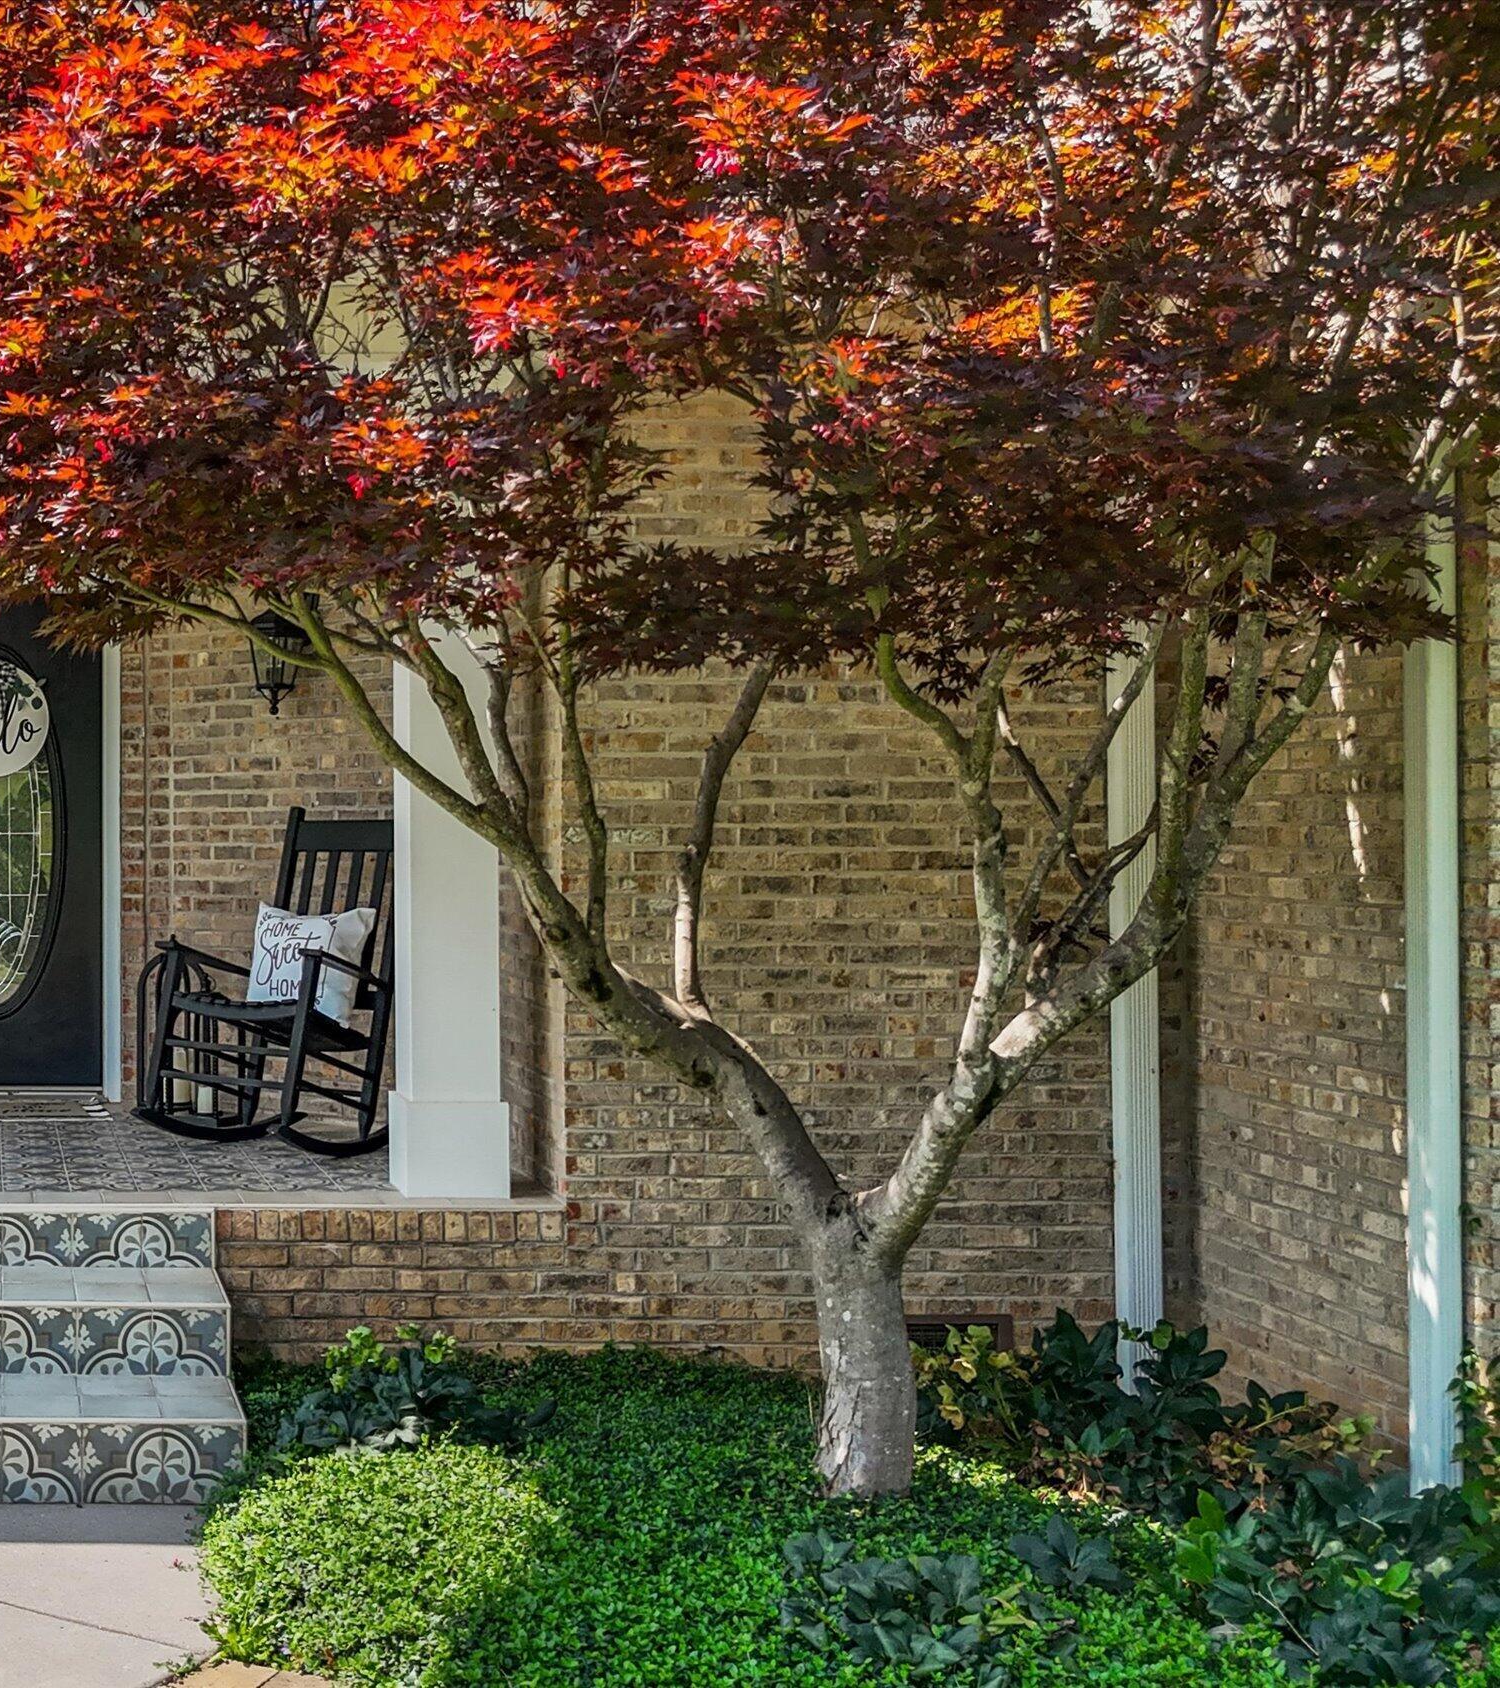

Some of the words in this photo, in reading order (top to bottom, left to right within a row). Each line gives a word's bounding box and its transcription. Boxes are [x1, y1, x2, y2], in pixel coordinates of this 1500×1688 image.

[264, 921, 303, 939] HOME
[256, 929, 322, 986] Sweet
[269, 978, 300, 997] HOM
